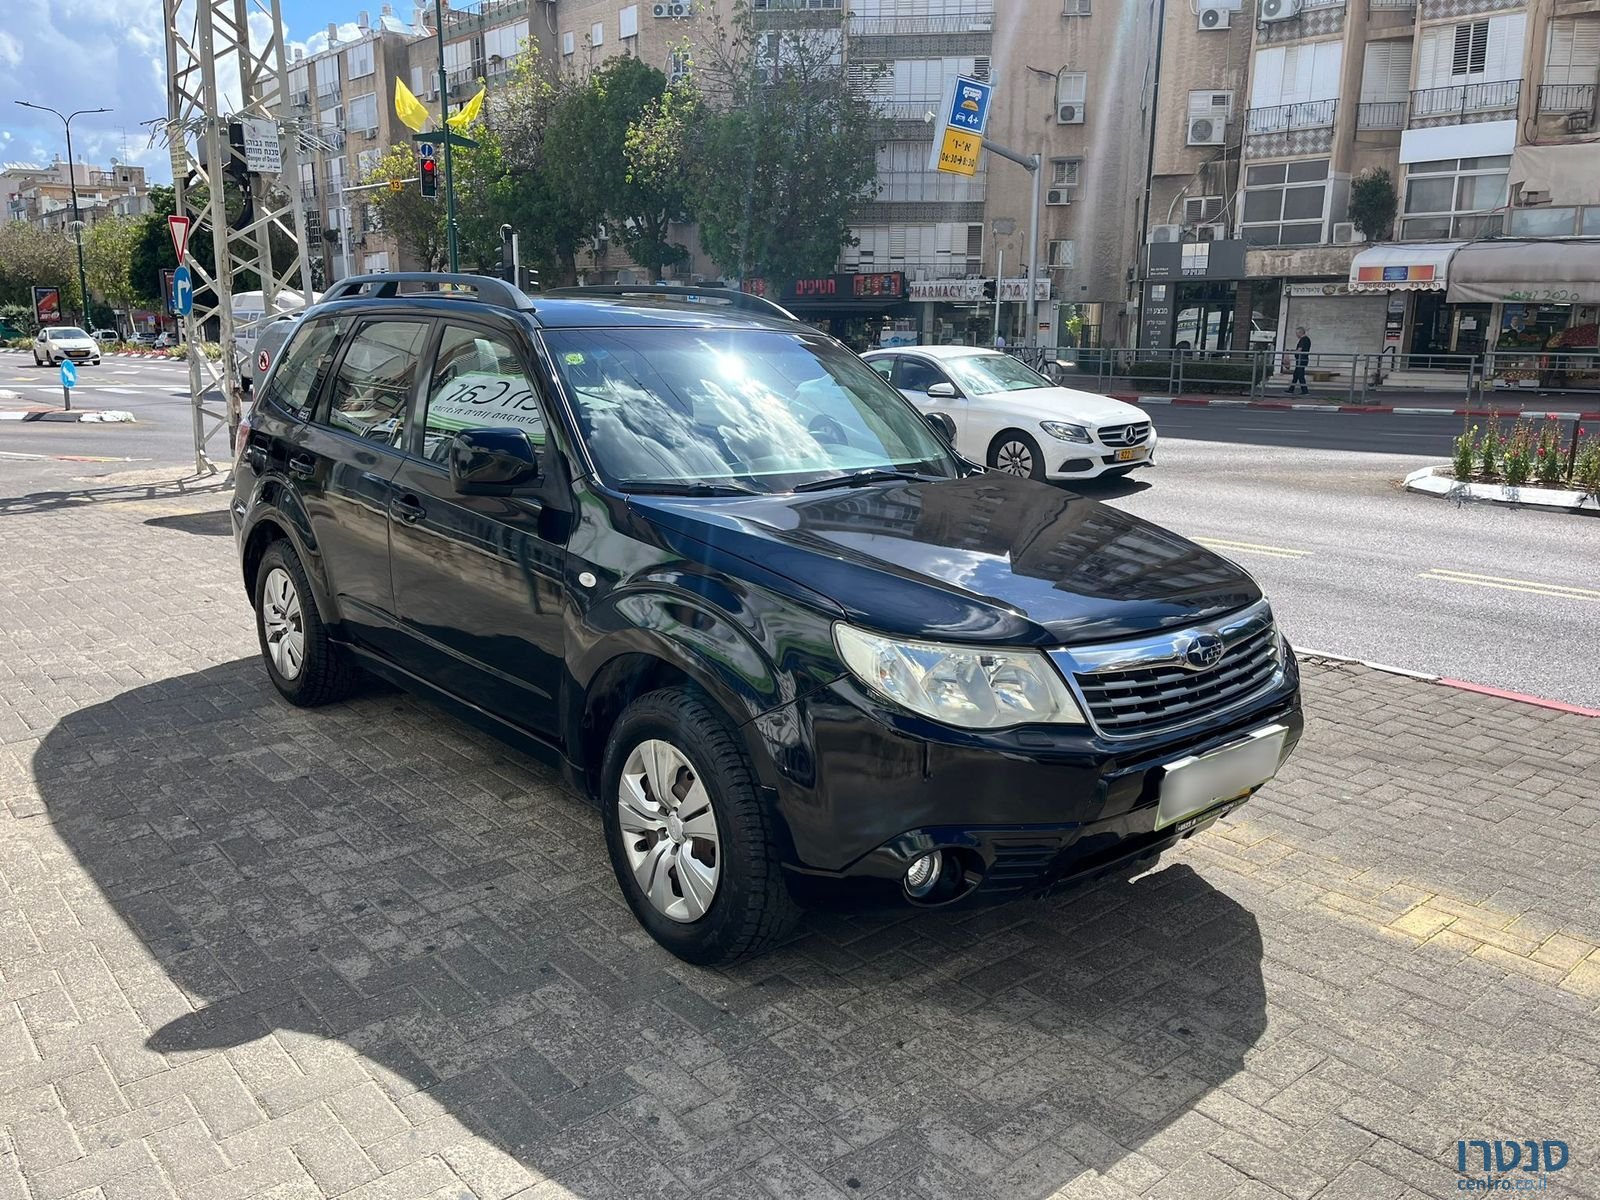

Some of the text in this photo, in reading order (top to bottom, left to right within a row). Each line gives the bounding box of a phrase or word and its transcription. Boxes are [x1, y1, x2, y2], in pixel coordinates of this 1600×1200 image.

[967, 115, 979, 124] 4+
[796, 279, 836, 295] חטיפים
[910, 285, 963, 298] PHARMACY
[1543, 290, 1579, 301] 2020
